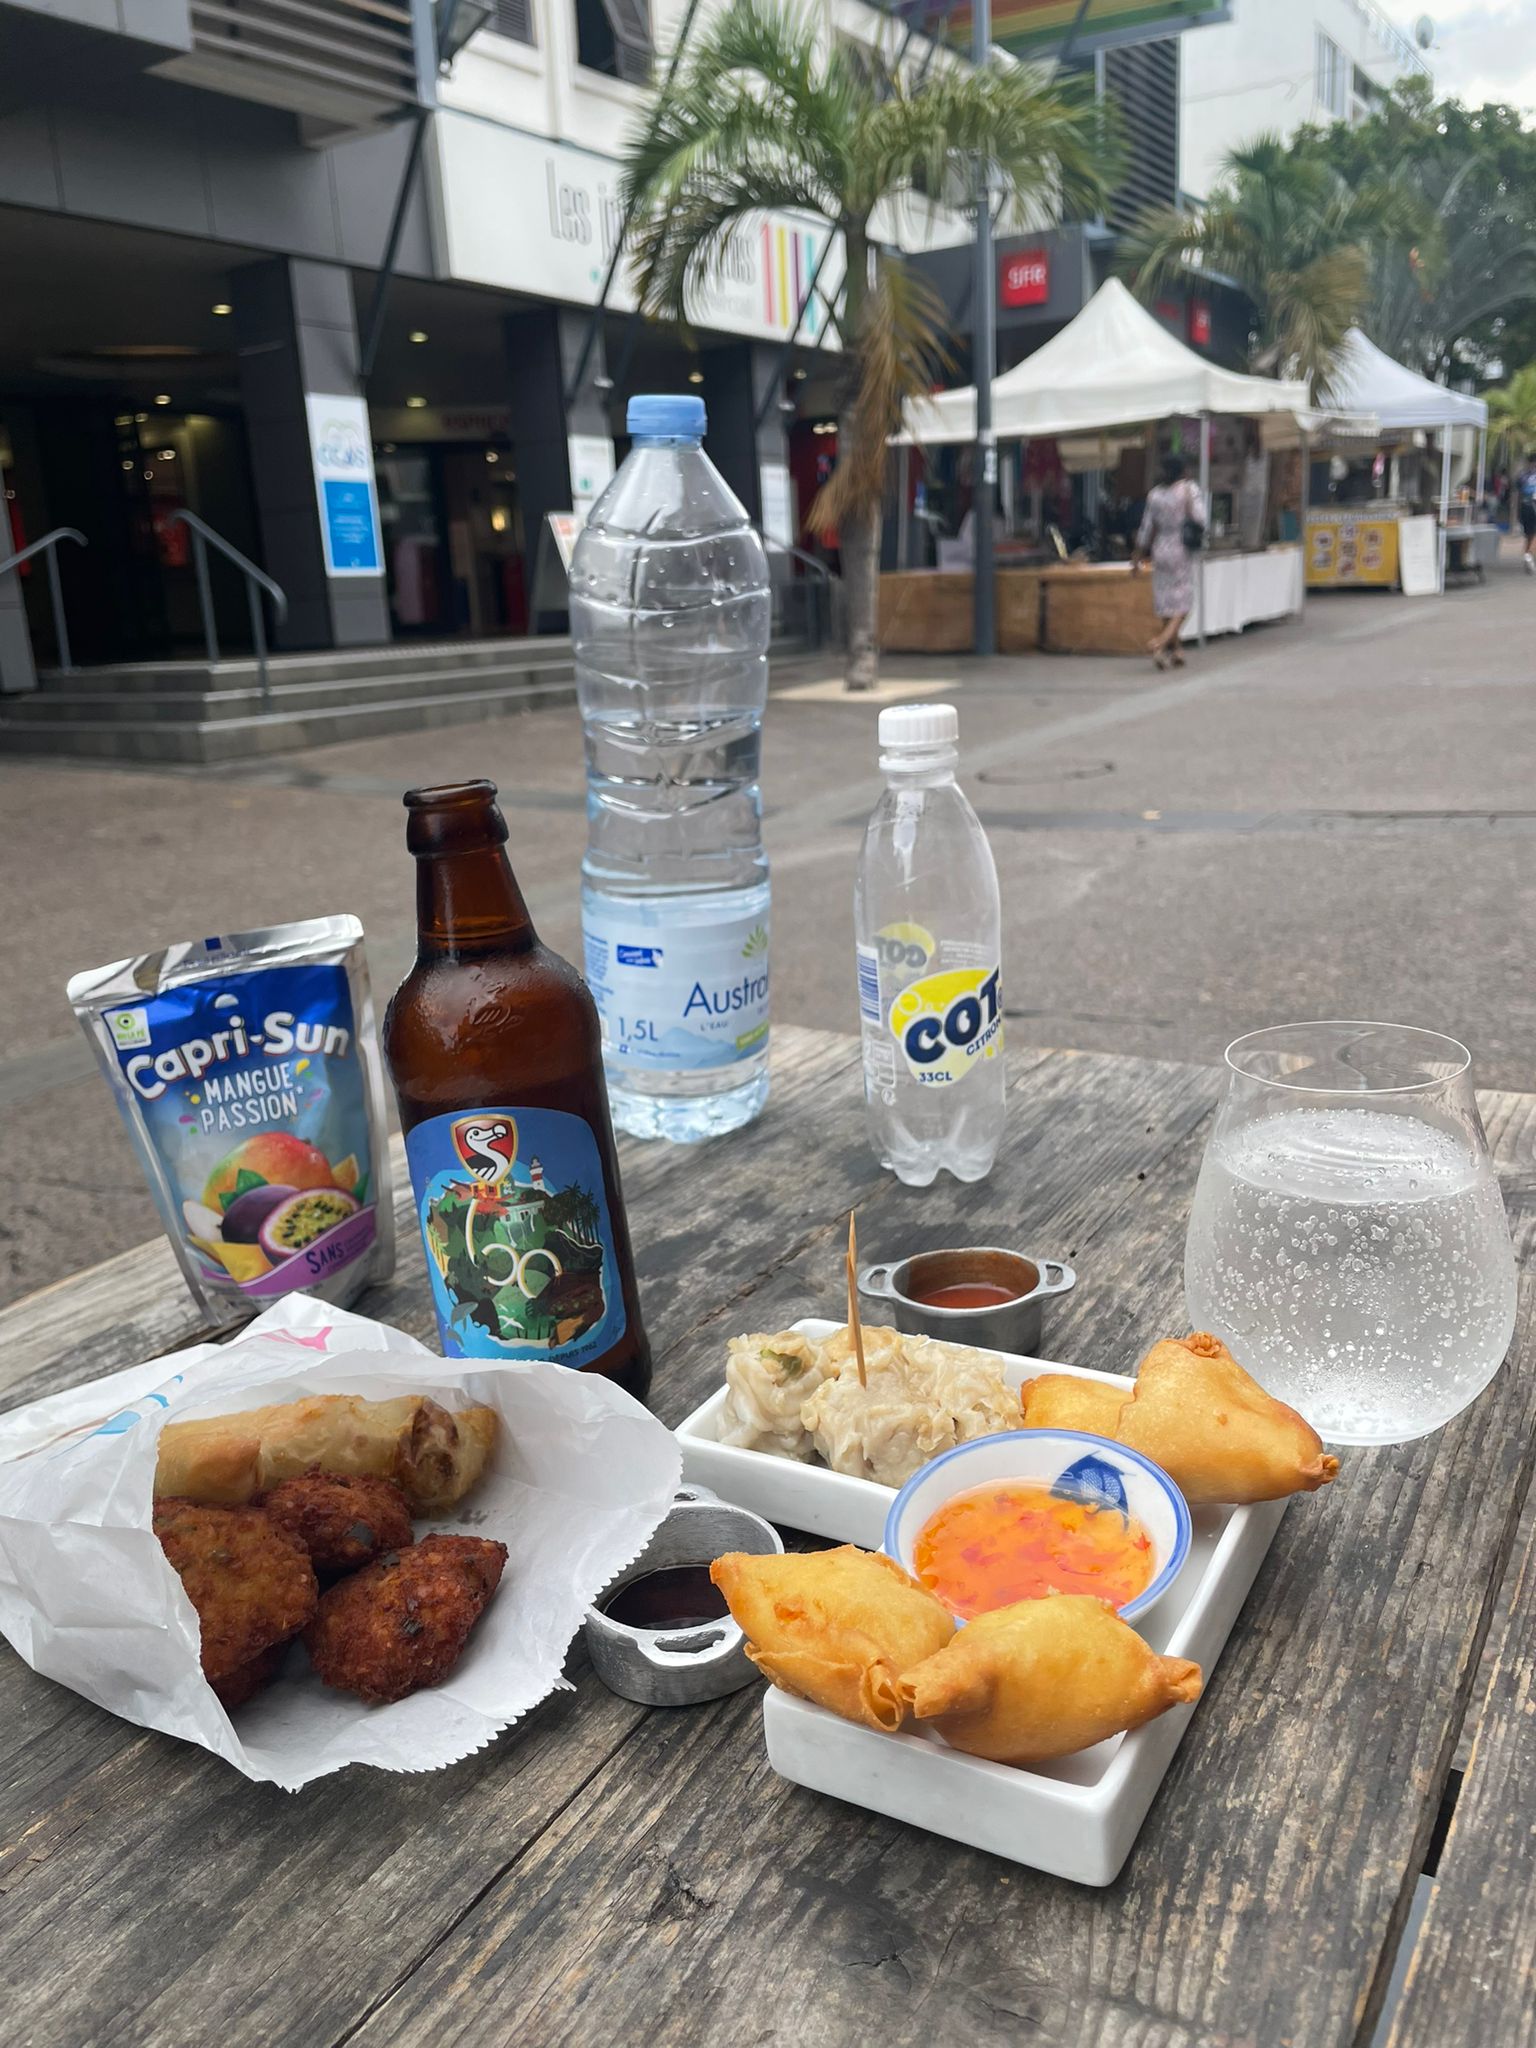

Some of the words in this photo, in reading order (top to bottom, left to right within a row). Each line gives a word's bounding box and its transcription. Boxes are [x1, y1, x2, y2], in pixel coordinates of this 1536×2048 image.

[618, 1017, 659, 1042] 1,5L
[905, 965, 999, 1064] COT
[126, 1011, 349, 1100] Capri-Sun
[919, 1072, 952, 1082] 33CL
[204, 1062, 294, 1105] MANGUE
